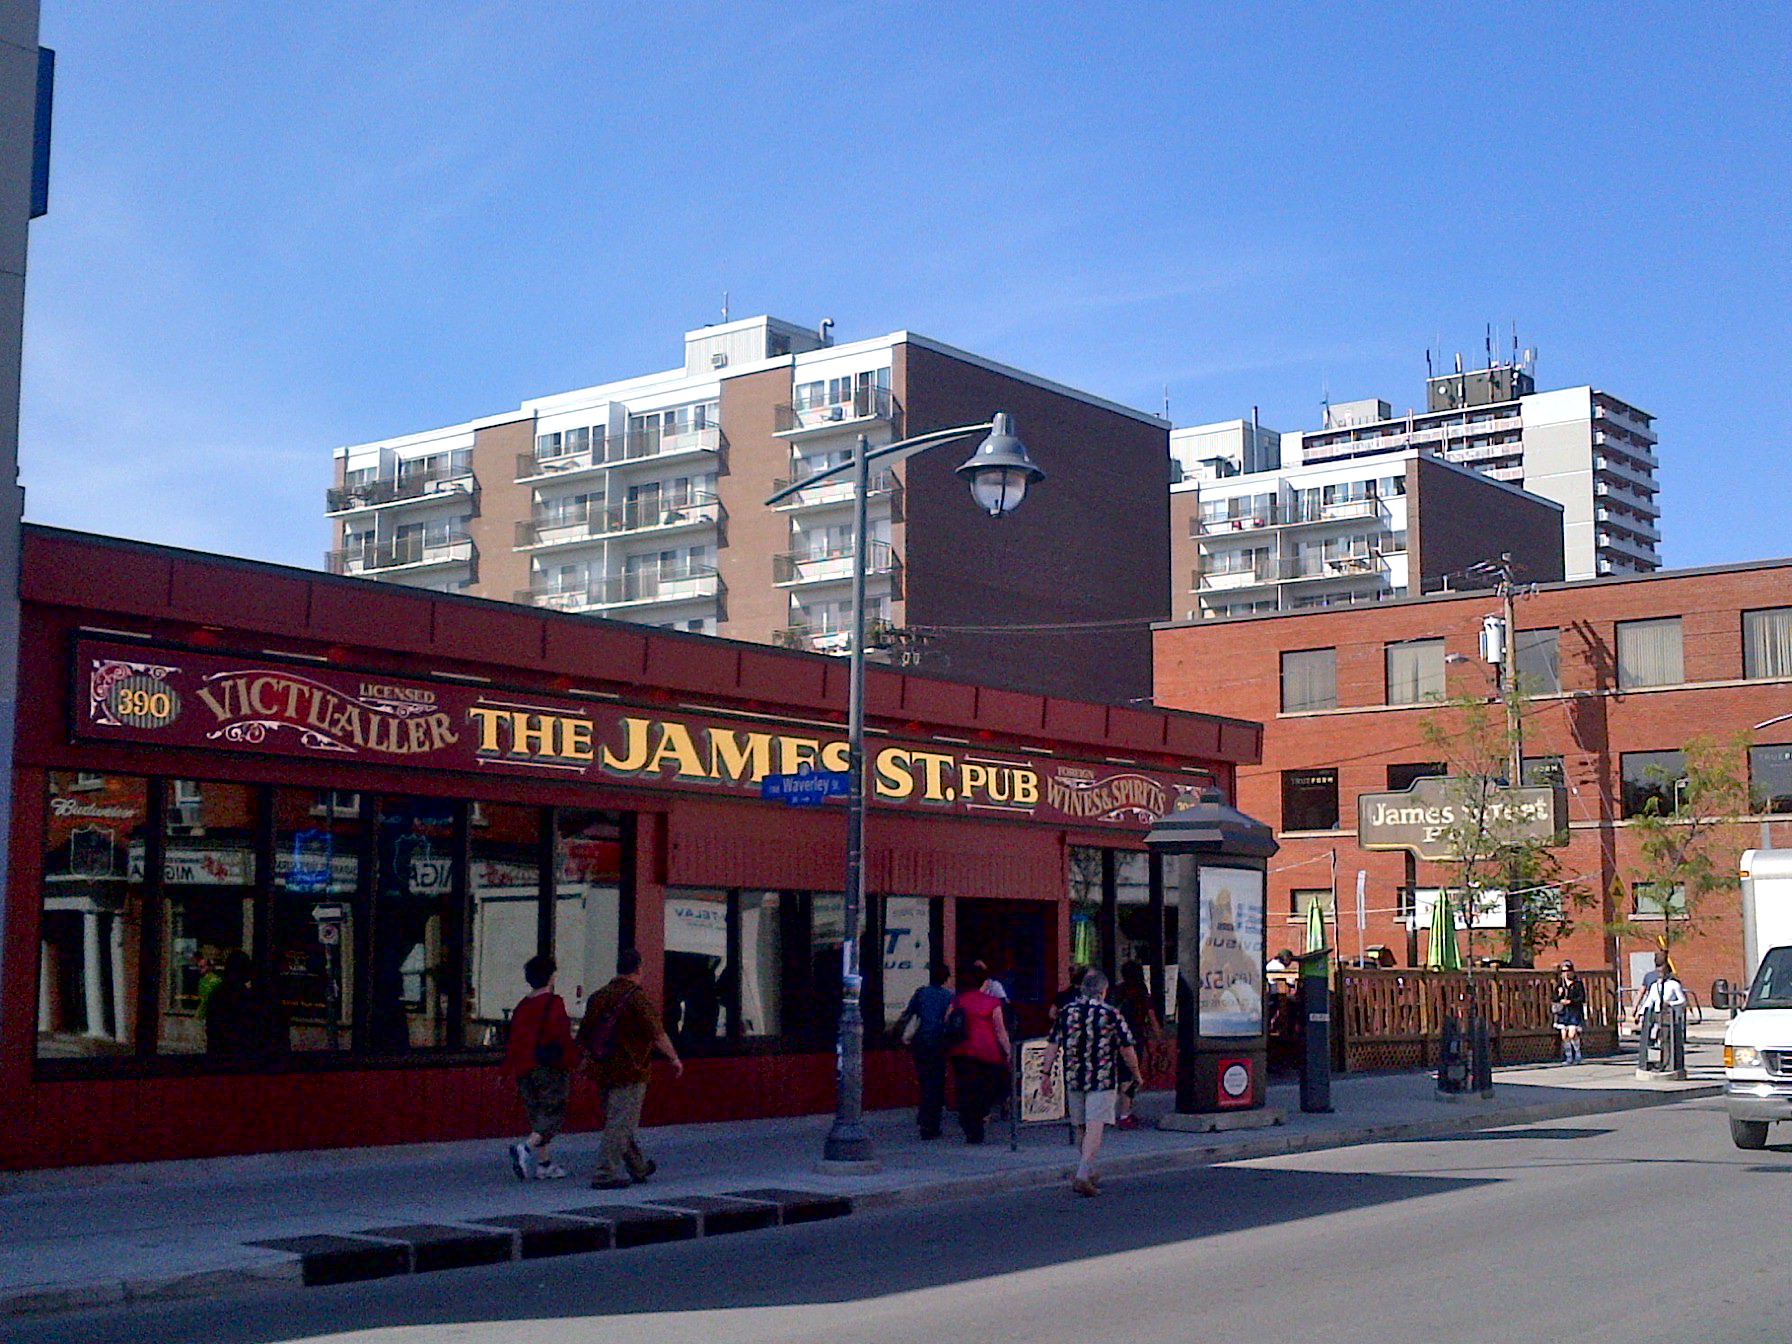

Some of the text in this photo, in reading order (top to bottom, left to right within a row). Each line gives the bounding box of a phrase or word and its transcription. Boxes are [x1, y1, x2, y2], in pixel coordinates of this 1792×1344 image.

[118, 688, 170, 719] 390
[358, 682, 436, 704] LICENSED
[195, 676, 461, 754] VICTUALLER
[468, 706, 595, 762] THE
[875, 746, 957, 803] ST.
[959, 763, 1041, 806] PUB
[782, 776, 829, 795] Waverley
[1372, 803, 1455, 827] James
